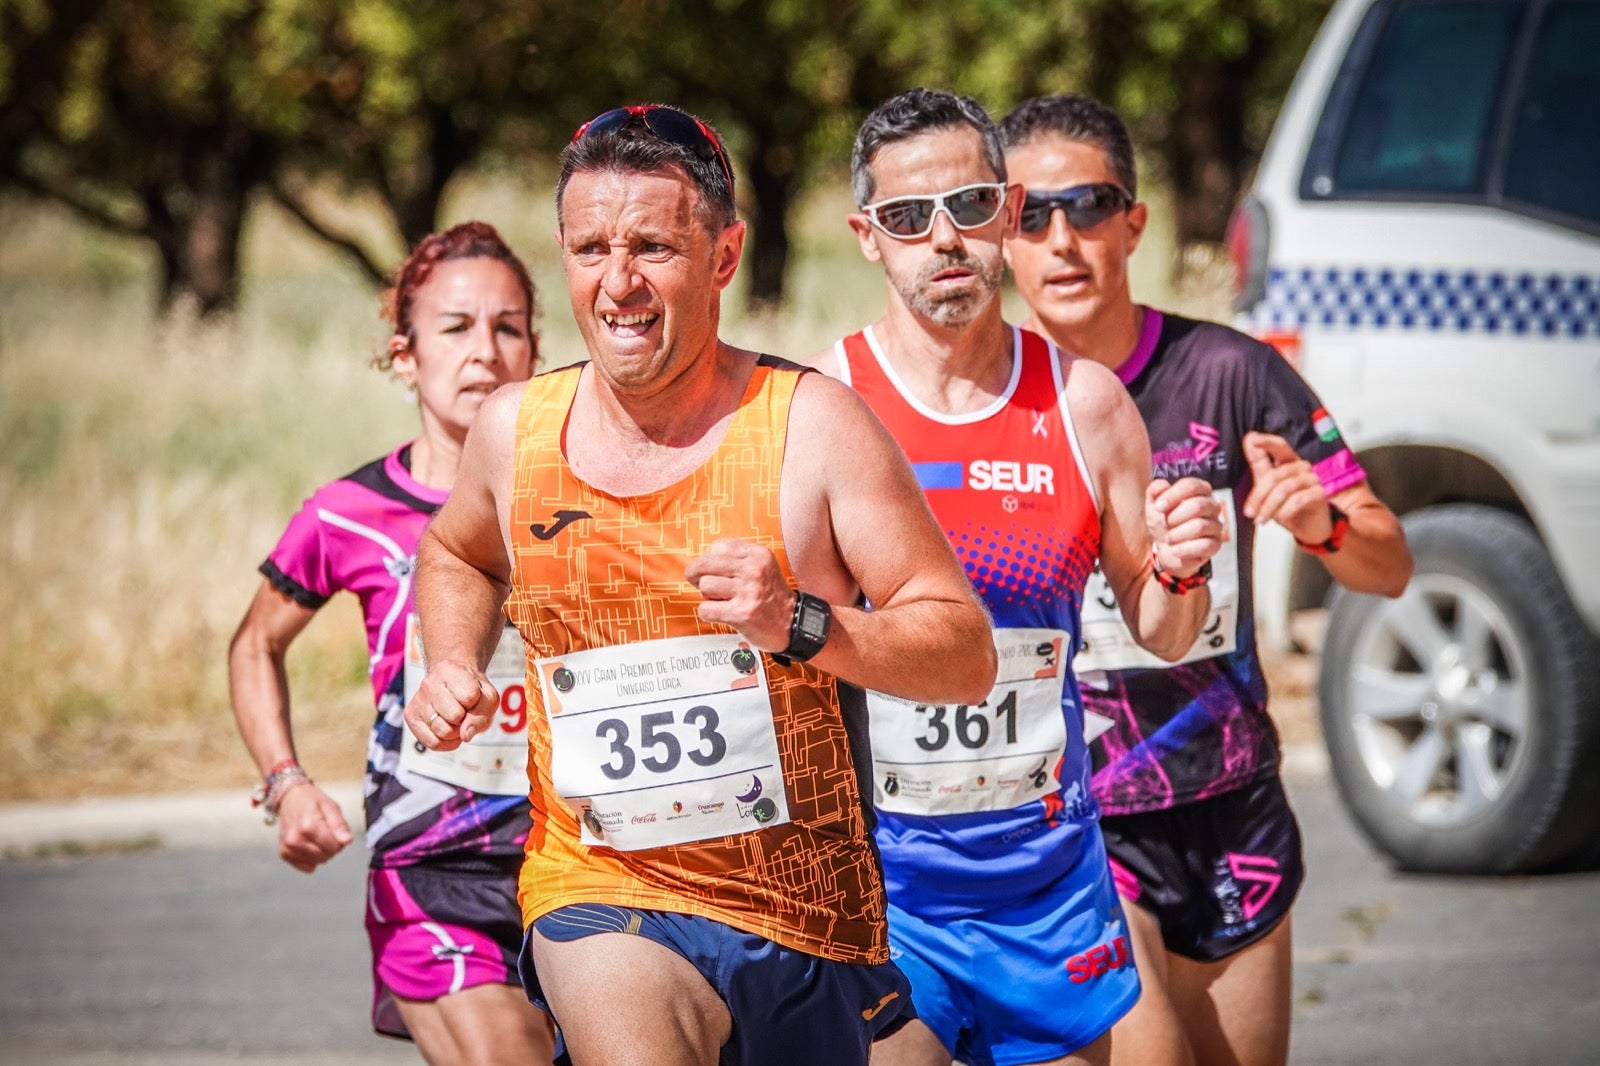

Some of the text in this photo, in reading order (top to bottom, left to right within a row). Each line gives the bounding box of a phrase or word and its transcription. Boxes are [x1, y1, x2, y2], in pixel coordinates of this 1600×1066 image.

[968, 459, 1055, 495] SEUR
[1152, 458, 1201, 478] ANTA
[1205, 450, 1228, 471] FE
[703, 648, 730, 668] 2022
[915, 690, 1018, 752] 361
[595, 705, 727, 781] 353
